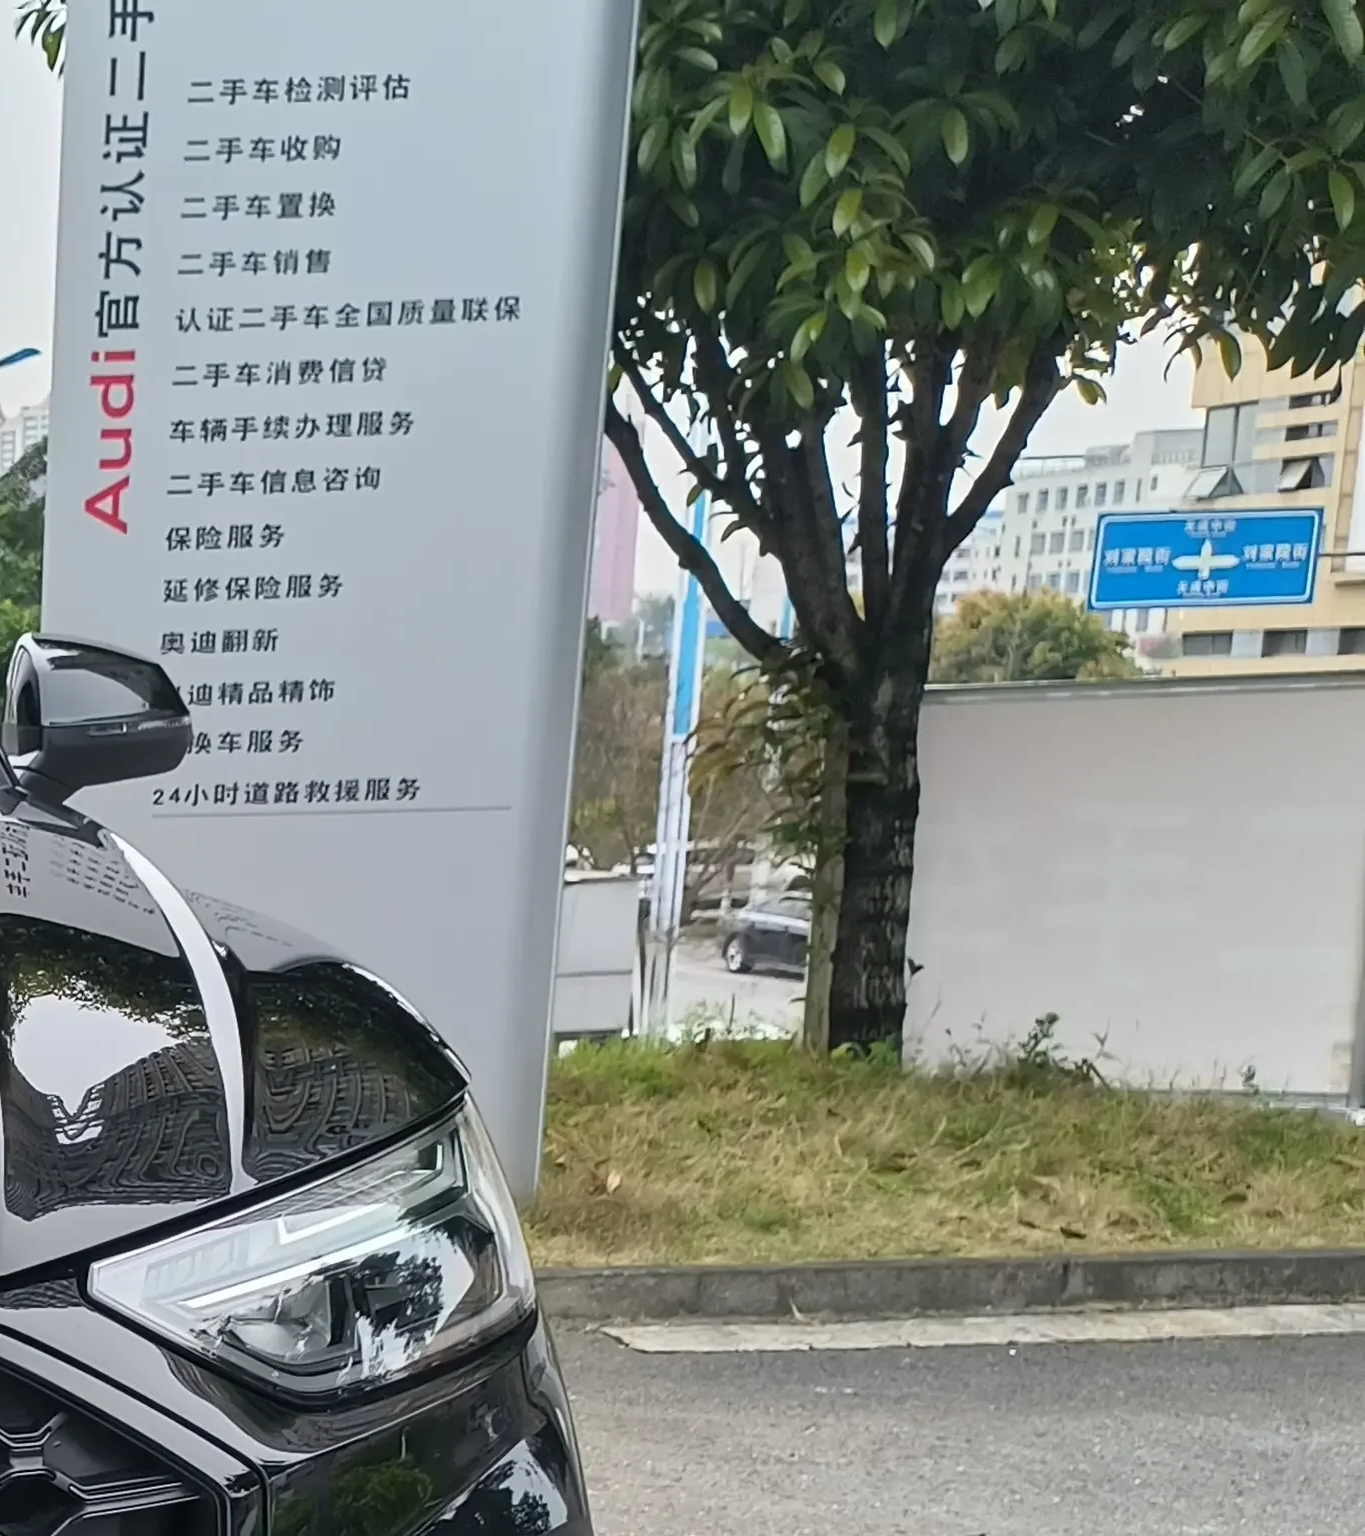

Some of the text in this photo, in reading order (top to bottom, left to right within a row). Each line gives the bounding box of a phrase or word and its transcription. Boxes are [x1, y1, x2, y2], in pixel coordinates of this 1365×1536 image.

[187, 74, 411, 106] 二手车检测评估
[183, 134, 342, 164] 二手车收购
[180, 191, 336, 221] 二手车置换
[84, 0, 155, 534] Audi 官方认证二手
[178, 249, 332, 277] 二手车销售
[175, 297, 521, 333] 认证二手车全国质量联保
[172, 358, 387, 388] 二手车消费信贷
[169, 411, 415, 444] 车辆手续办理服务
[166, 466, 381, 497] 二手车信息咨询
[165, 523, 285, 552] 保险服务
[163, 573, 344, 604] 延修保险服务
[160, 628, 280, 656] 奥迪翻新
[176, 680, 336, 707] 迪精品精饰
[187, 729, 305, 754] 换车服务
[152, 777, 421, 808] 24小时道路救援服务
